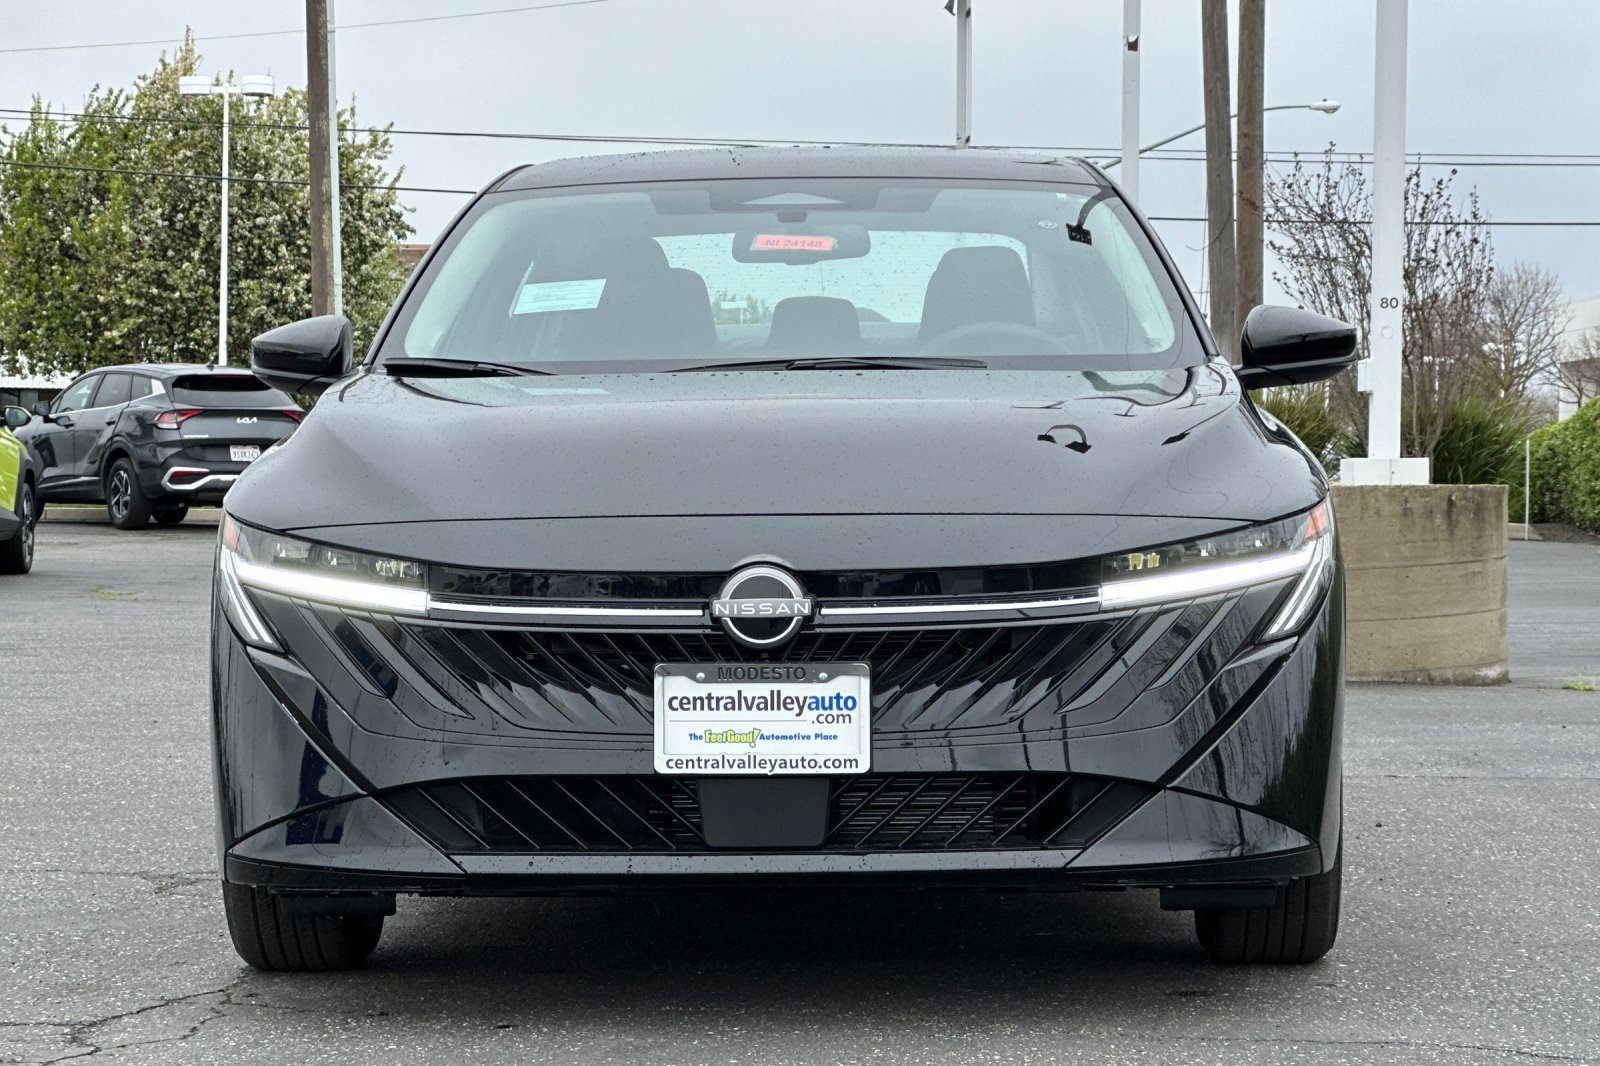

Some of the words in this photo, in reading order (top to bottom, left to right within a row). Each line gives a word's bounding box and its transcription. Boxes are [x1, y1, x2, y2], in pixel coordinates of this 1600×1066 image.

[783, 240, 823, 248] 24148
[1380, 297, 1399, 309] 80
[715, 603, 809, 615] NISSAN
[717, 666, 807, 681] MODESTO
[667, 690, 858, 717] centralvalleyauto
[811, 713, 852, 725] .com
[688, 733, 704, 741] The
[759, 733, 812, 741] Automotive
[814, 733, 838, 741] Place
[665, 754, 859, 774] centralvalleyauto.com
